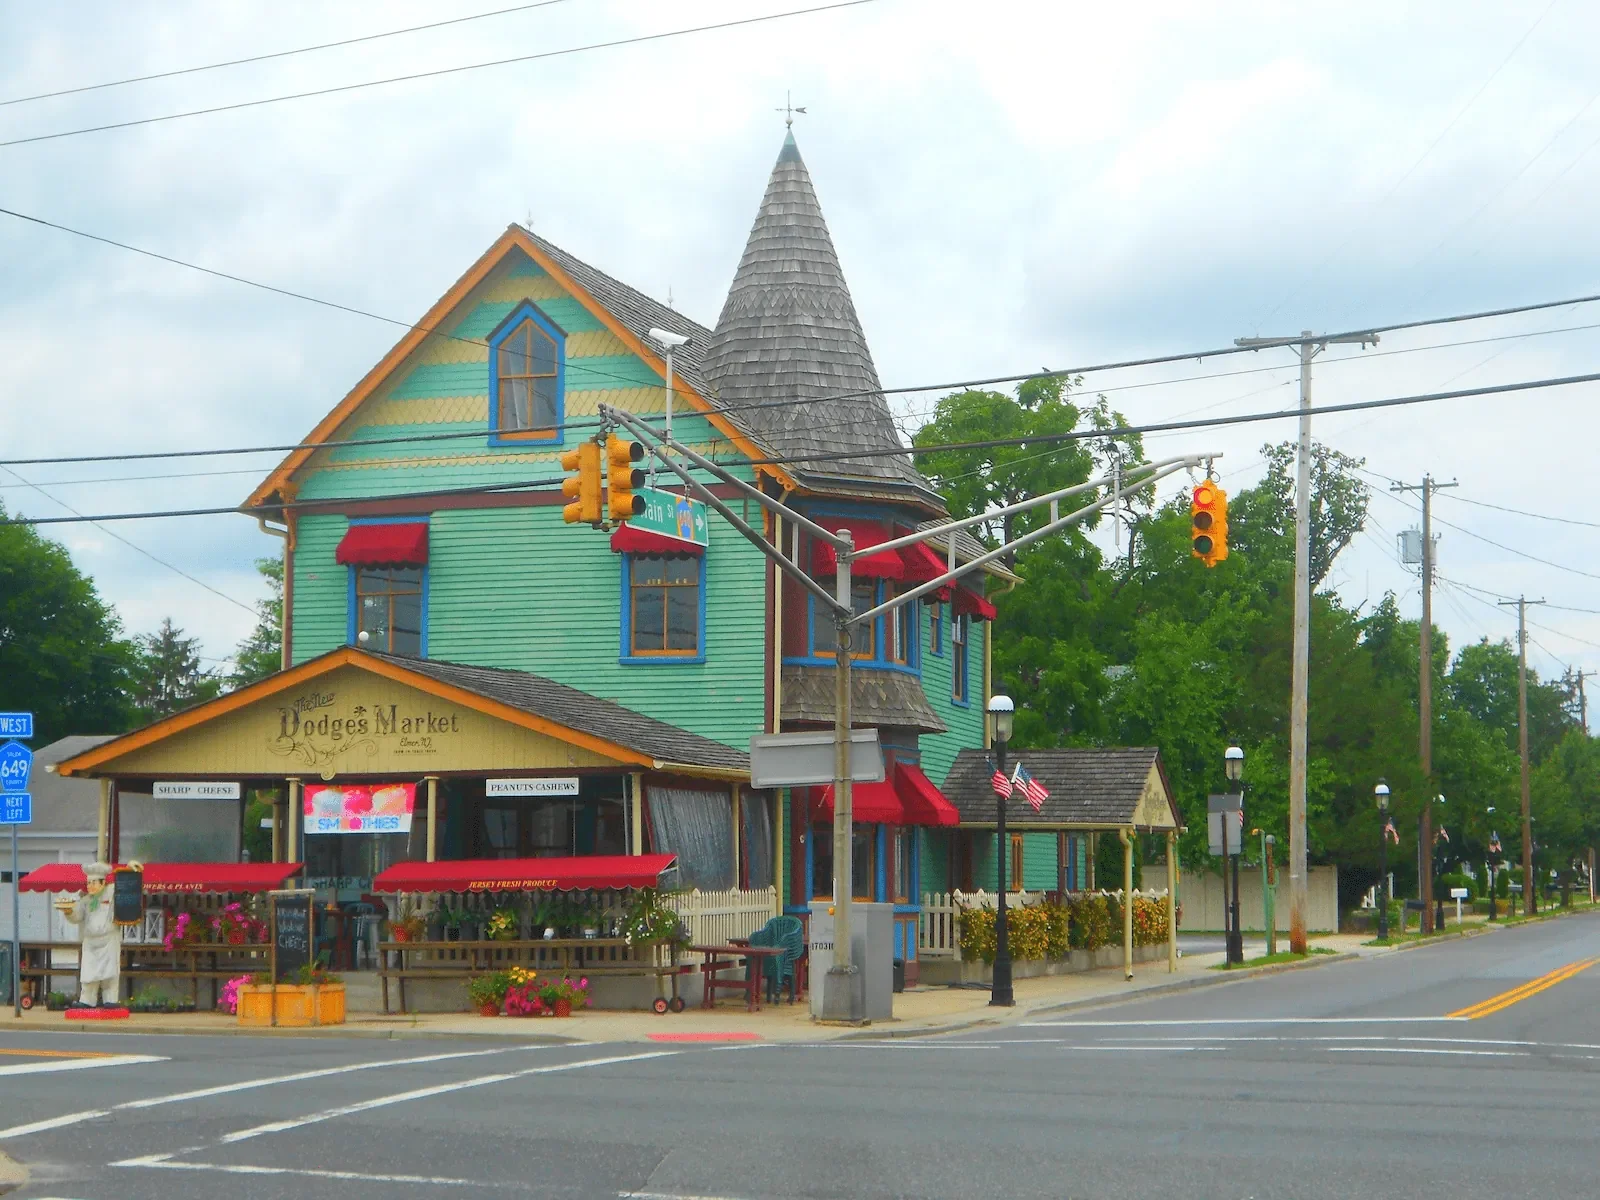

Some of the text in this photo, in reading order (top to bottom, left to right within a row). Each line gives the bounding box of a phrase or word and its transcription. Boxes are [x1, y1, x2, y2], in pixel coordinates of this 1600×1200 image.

[667, 504, 673, 518] St
[373, 704, 459, 735] Market
[0, 718, 27, 733] WEST
[1, 759, 28, 778] 649
[159, 786, 234, 795] SHARP CHEESE
[491, 782, 576, 792] PEANUTS CASHEWS
[6, 797, 23, 807] NEXT
[6, 809, 23, 819] LEFT
[496, 880, 521, 888] FRESH
[522, 879, 558, 887] PRODUCE
